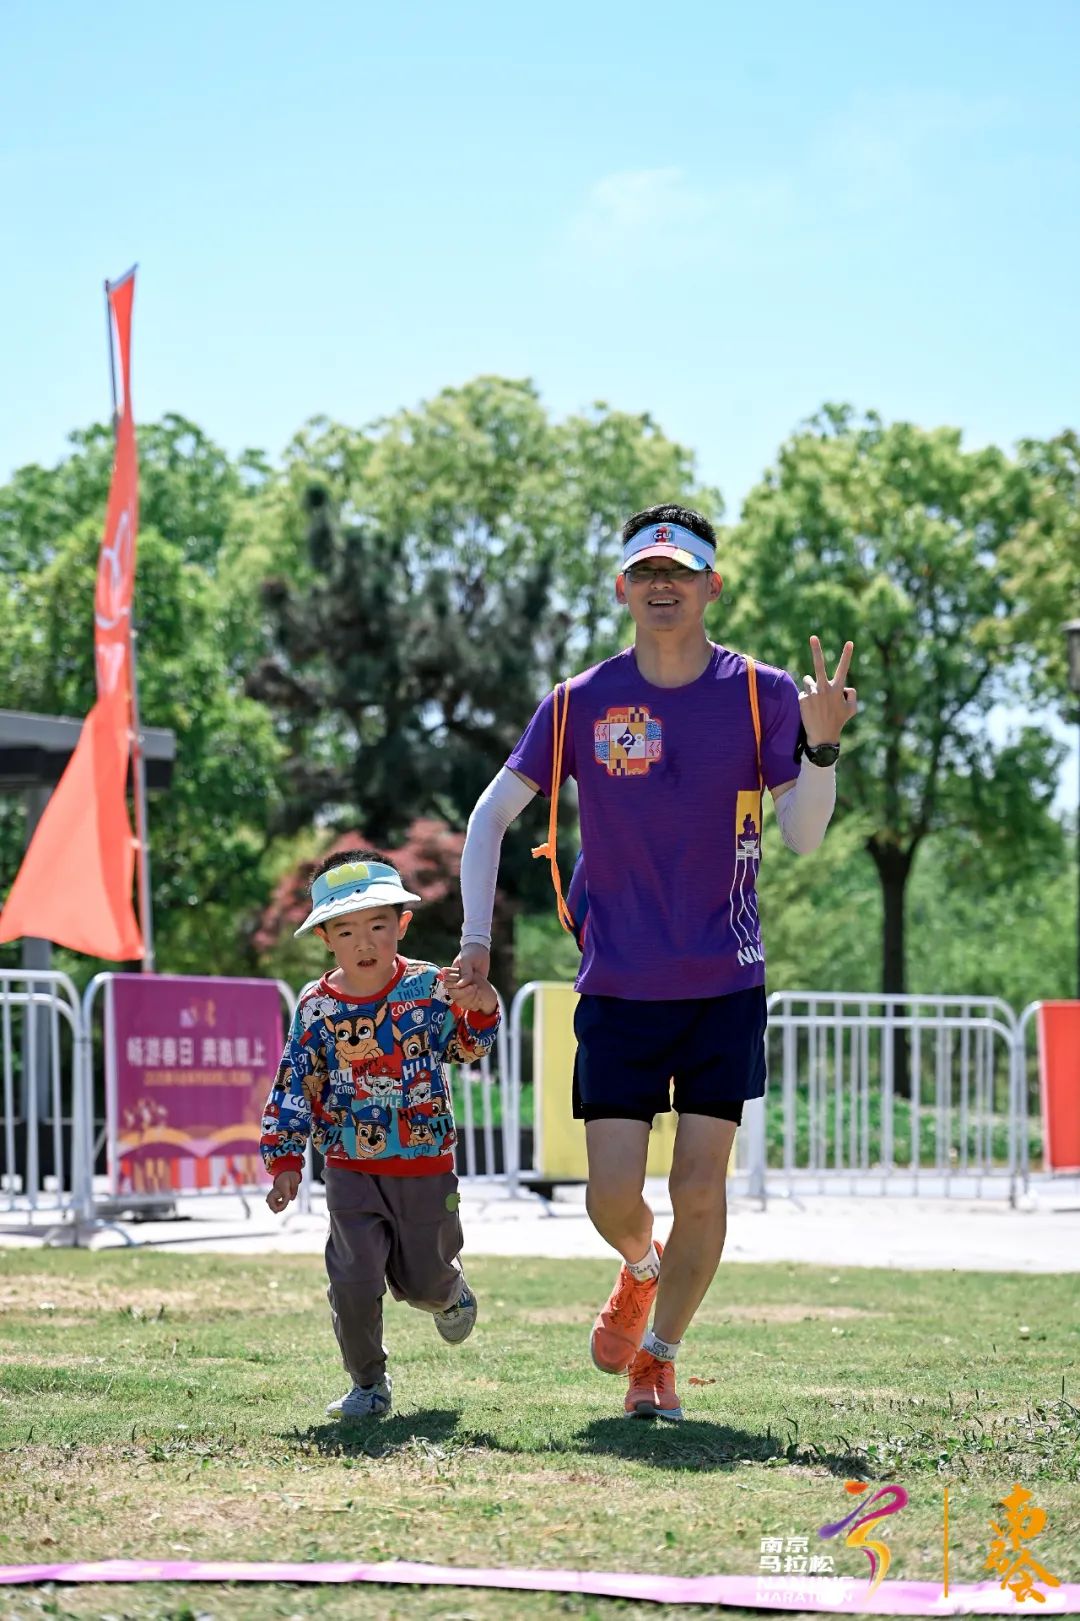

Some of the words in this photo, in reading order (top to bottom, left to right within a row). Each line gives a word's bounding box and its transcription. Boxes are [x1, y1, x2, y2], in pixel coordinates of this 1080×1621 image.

[612, 733, 645, 749] 128
[397, 986, 425, 1002] THIS!
[364, 1096, 403, 1109] SMILE
